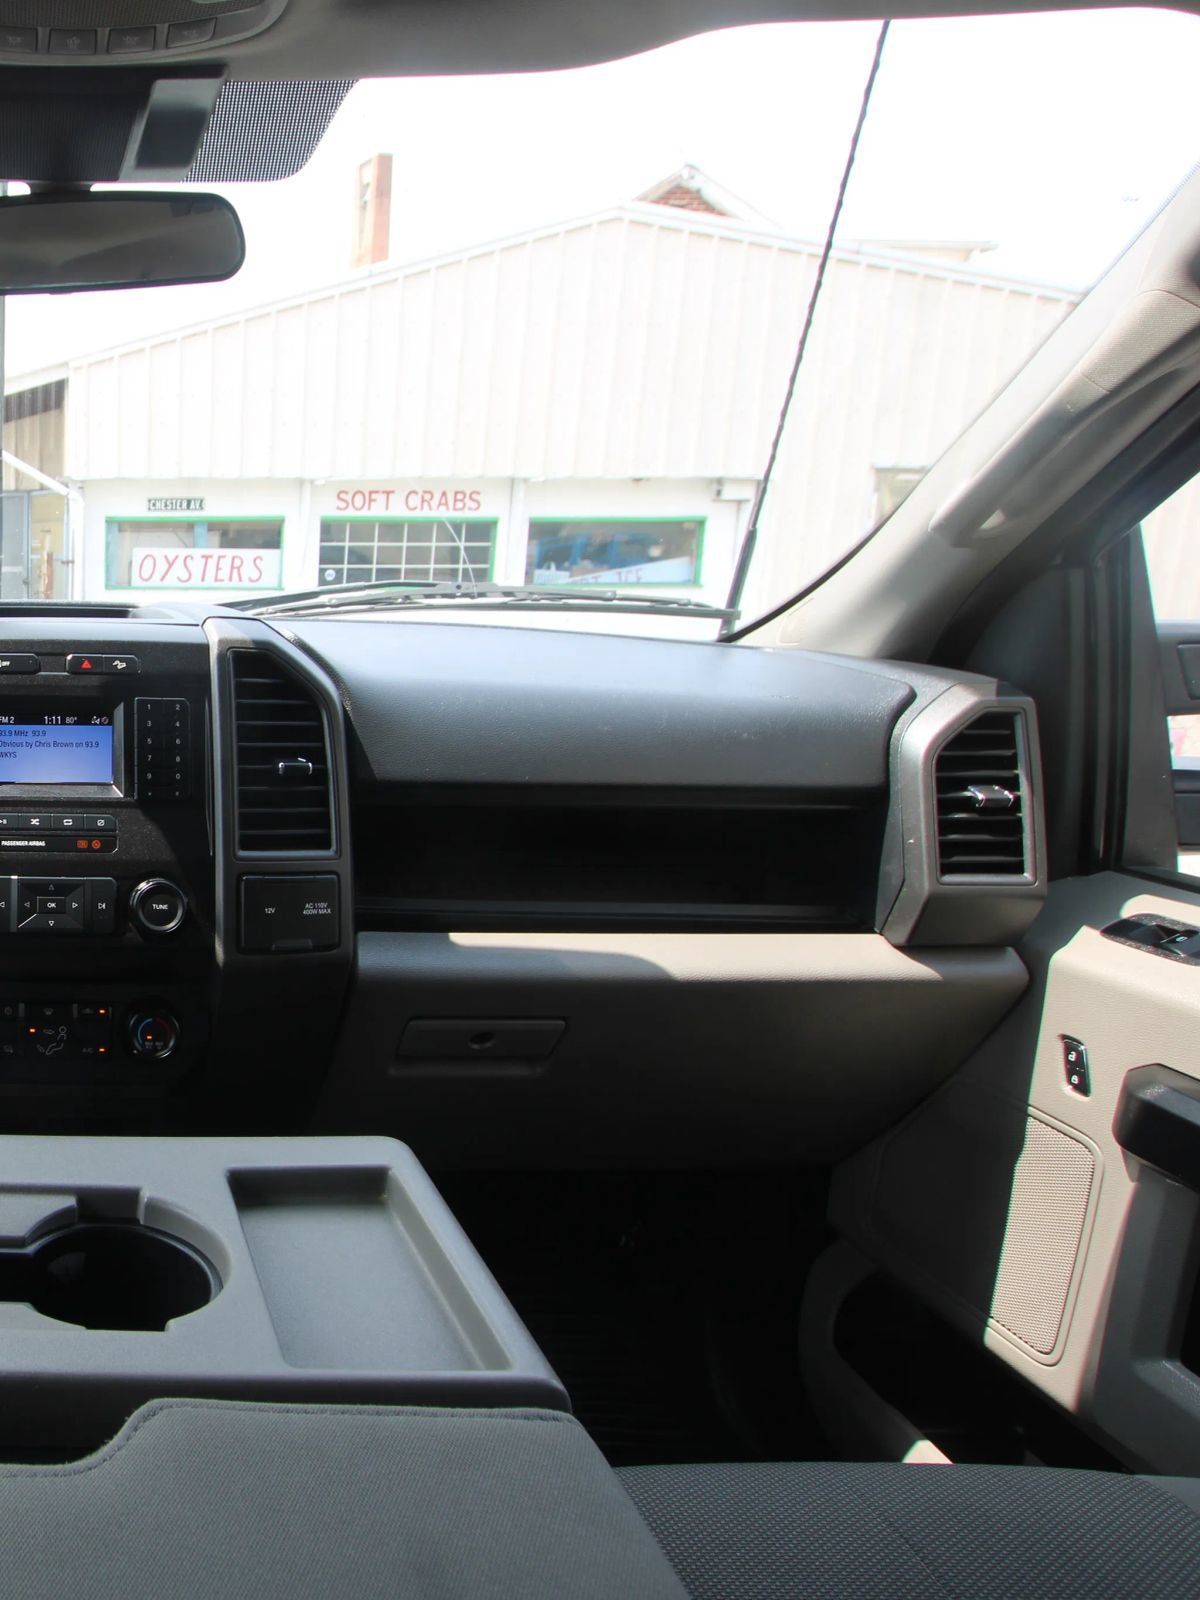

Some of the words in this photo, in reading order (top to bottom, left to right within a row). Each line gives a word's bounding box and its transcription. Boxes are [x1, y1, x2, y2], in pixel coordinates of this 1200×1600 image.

[150, 499, 187, 510] CHESTER
[335, 489, 395, 512] SOFT
[404, 489, 482, 512] CRABS
[138, 554, 264, 583] OYSTERS
[10, 716, 15, 724] 2
[43, 716, 61, 725] 1:11
[13, 729, 28, 737] MHz
[31, 729, 47, 737] 93.9
[25, 740, 33, 749] by
[34, 740, 51, 748] Chris
[52, 740, 74, 748] Brown
[84, 740, 100, 748] 93.9
